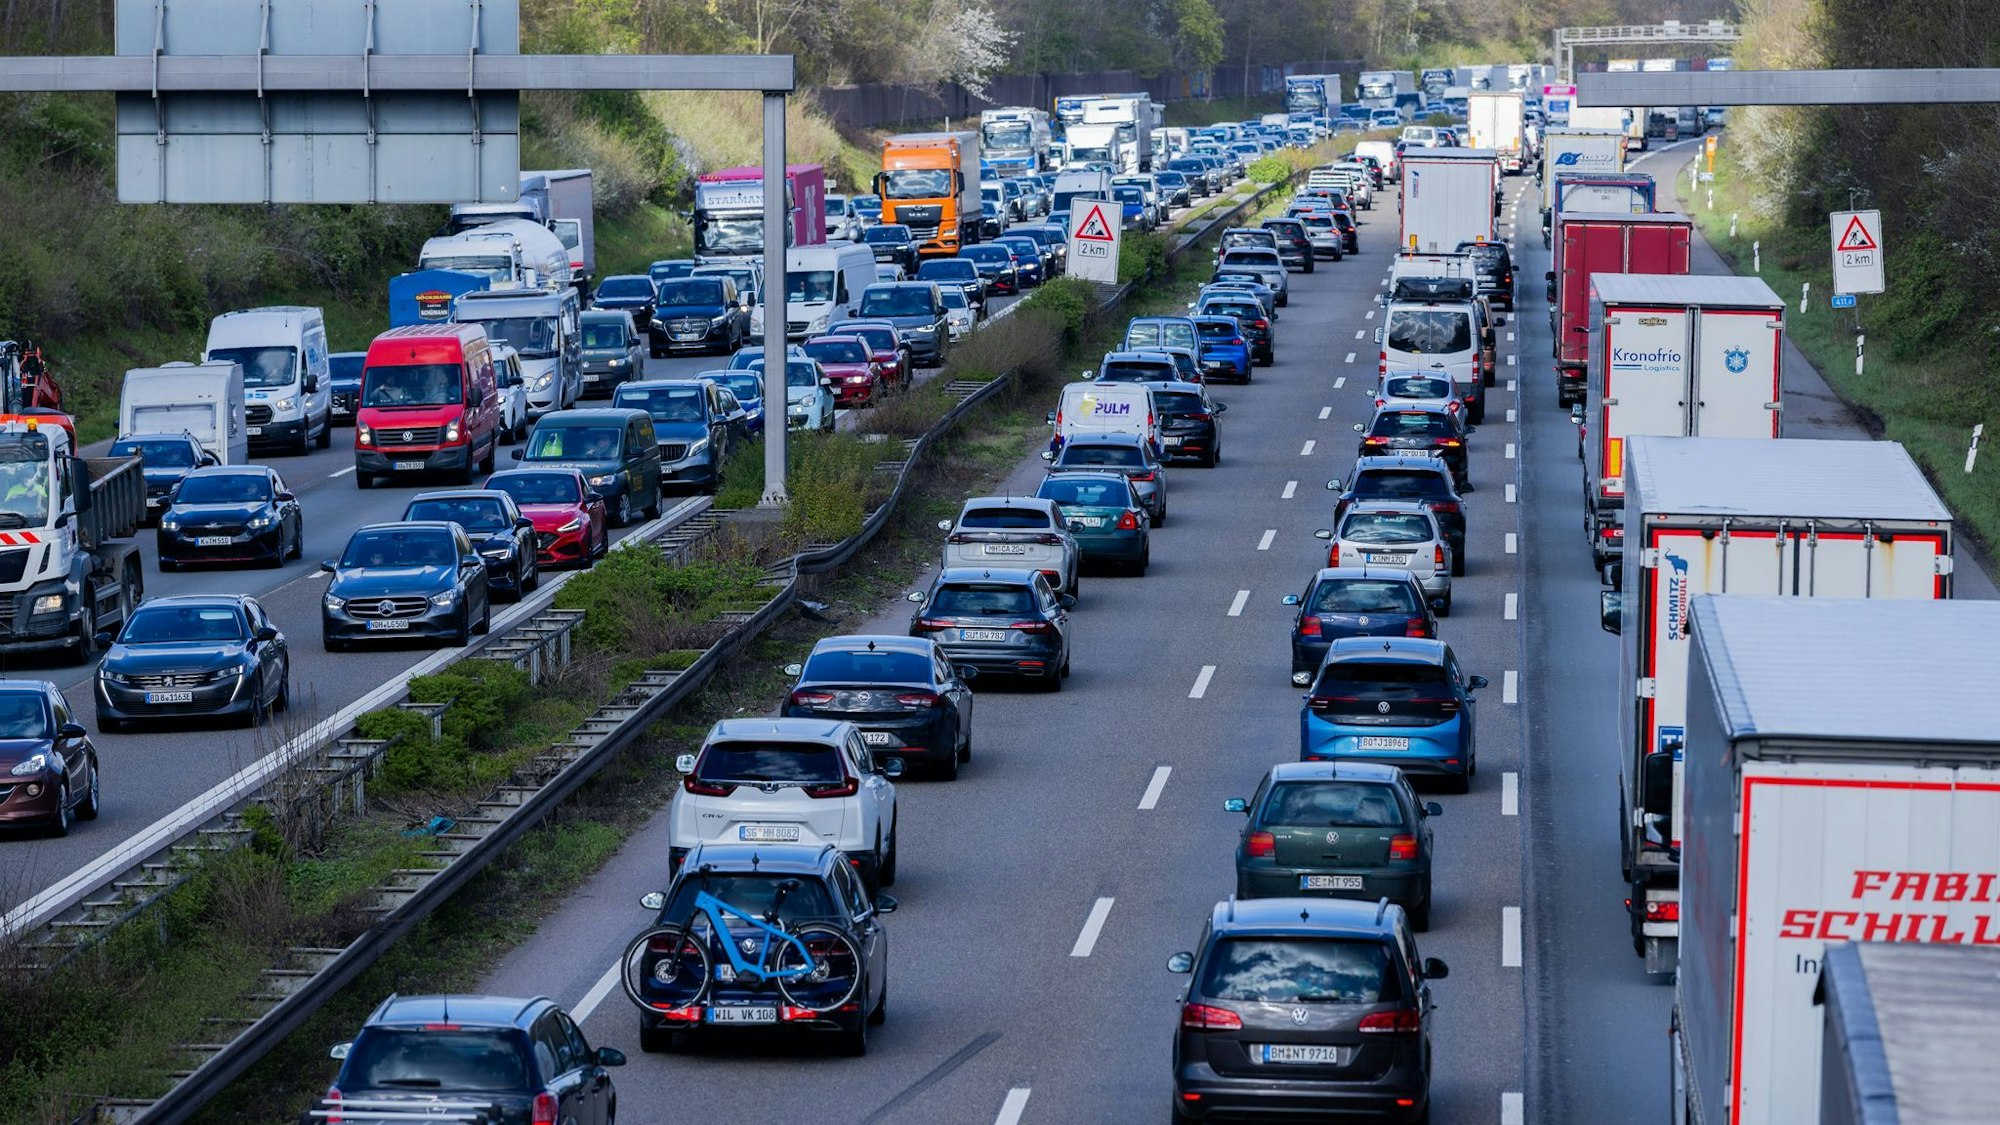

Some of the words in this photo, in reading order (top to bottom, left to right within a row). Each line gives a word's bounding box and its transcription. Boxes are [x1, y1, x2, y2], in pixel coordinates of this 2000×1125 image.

[1082, 243, 1088, 253] 2
[1090, 243, 1105, 255] km
[1846, 255, 1852, 264] 2
[1855, 254, 1870, 264] km
[1613, 348, 1681, 362] Kronofrío
[1644, 364, 1680, 372] Logistics
[1095, 403, 1130, 414] PULM
[1668, 578, 1679, 640] SCHMITZ
[746, 828, 757, 837] SG
[763, 828, 775, 837] HH
[776, 828, 798, 838] 8082
[1309, 878, 1321, 887] SE
[1328, 878, 1340, 887] MT
[1344, 878, 1361, 888] 955
[1851, 871, 2000, 903] FABI
[715, 1011, 734, 1020] WIL
[741, 1010, 754, 1020] VK
[757, 1010, 775, 1019] 108
[1271, 1048, 1285, 1059] BM
[1292, 1048, 1305, 1059] NT
[1309, 1049, 1335, 1060] 9716
